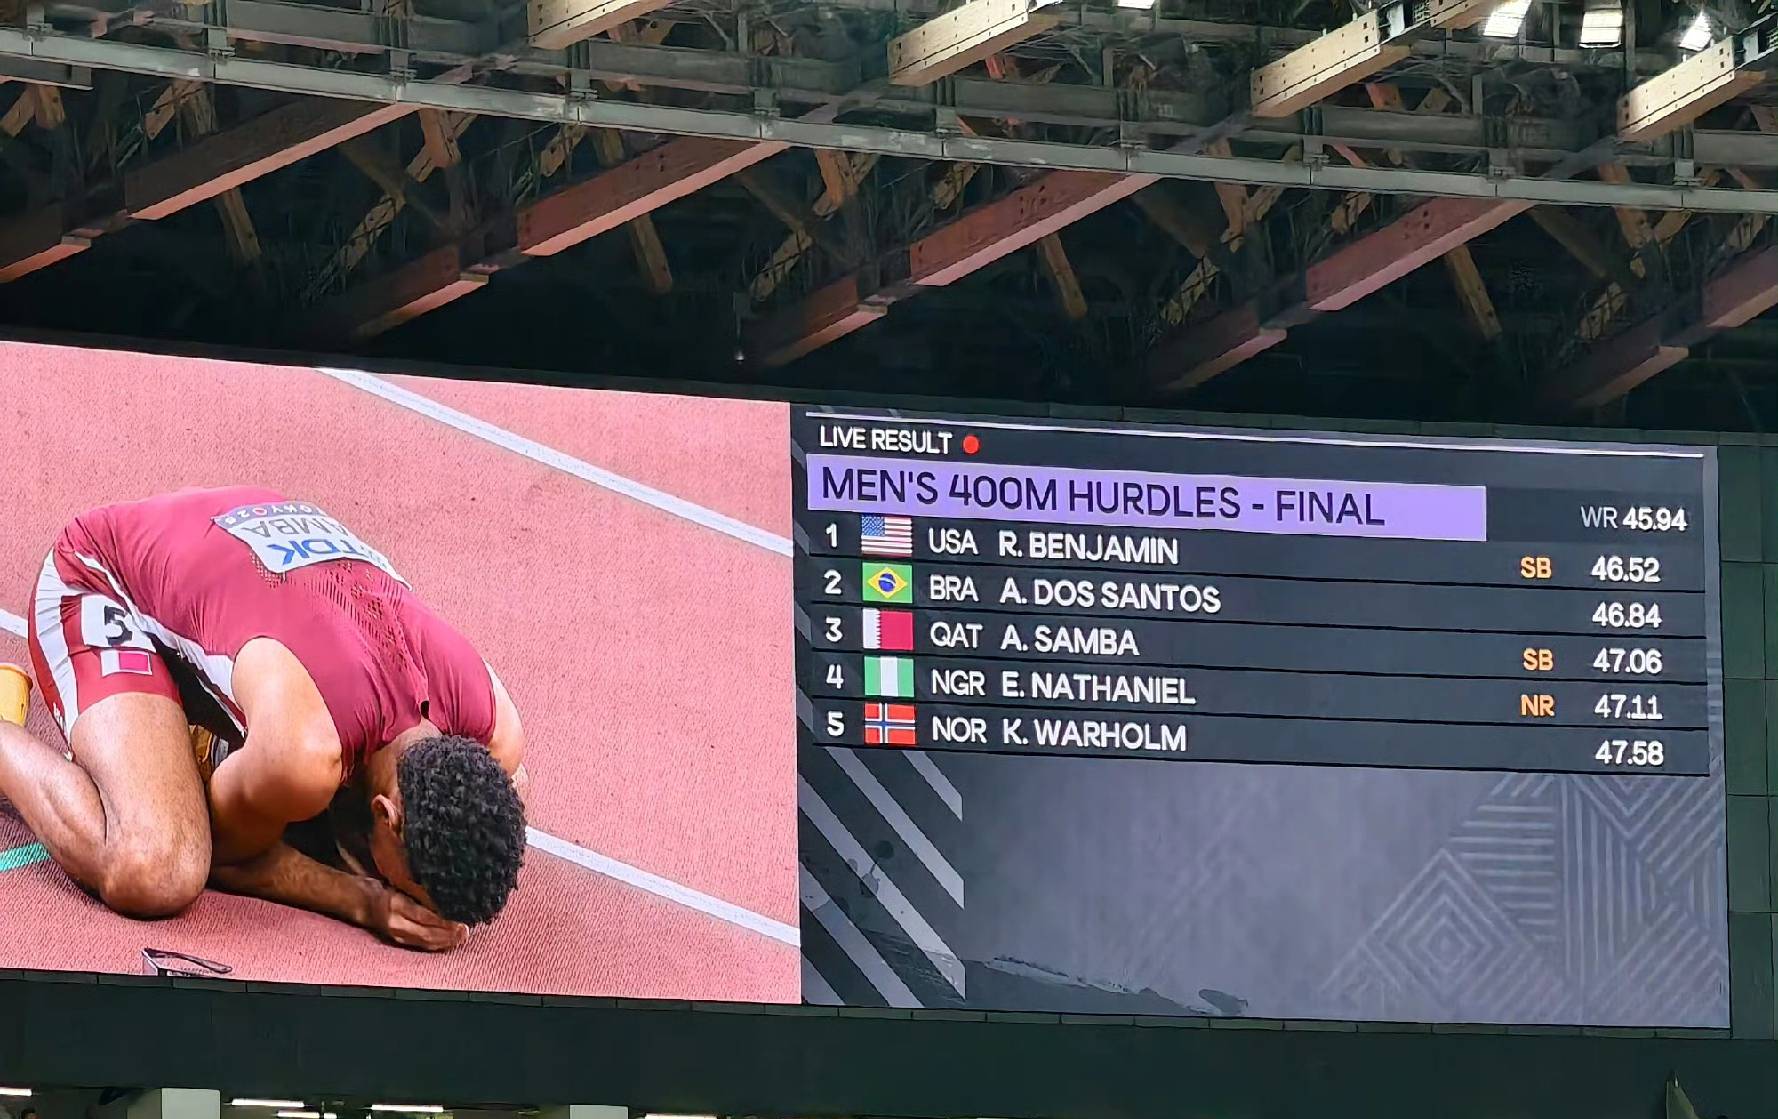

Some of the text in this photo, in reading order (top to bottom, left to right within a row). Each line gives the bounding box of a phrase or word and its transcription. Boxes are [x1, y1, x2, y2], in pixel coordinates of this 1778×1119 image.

[820, 427, 952, 454] LIVE RESULT
[822, 467, 938, 504] MEN'S
[949, 474, 1057, 511] 400M
[1070, 479, 1240, 518] HURDLES
[1276, 490, 1385, 526] FINAL
[1581, 506, 1687, 530] WR 45.94
[267, 538, 368, 565] TDK
[825, 524, 1661, 582] 1 USA R. BENJAMIN SB 46.52
[103, 605, 134, 646] 5
[824, 571, 1662, 628] 2 BRA A. DOS SANTOS 46.84
[825, 617, 1663, 674] 3 QAT A. SAMBA SB 47.06
[826, 665, 1664, 720] 4 NGR E. NATHANIEL NR 47.11
[828, 712, 1664, 765] 5 NOR K. WARHOLM 47.58
